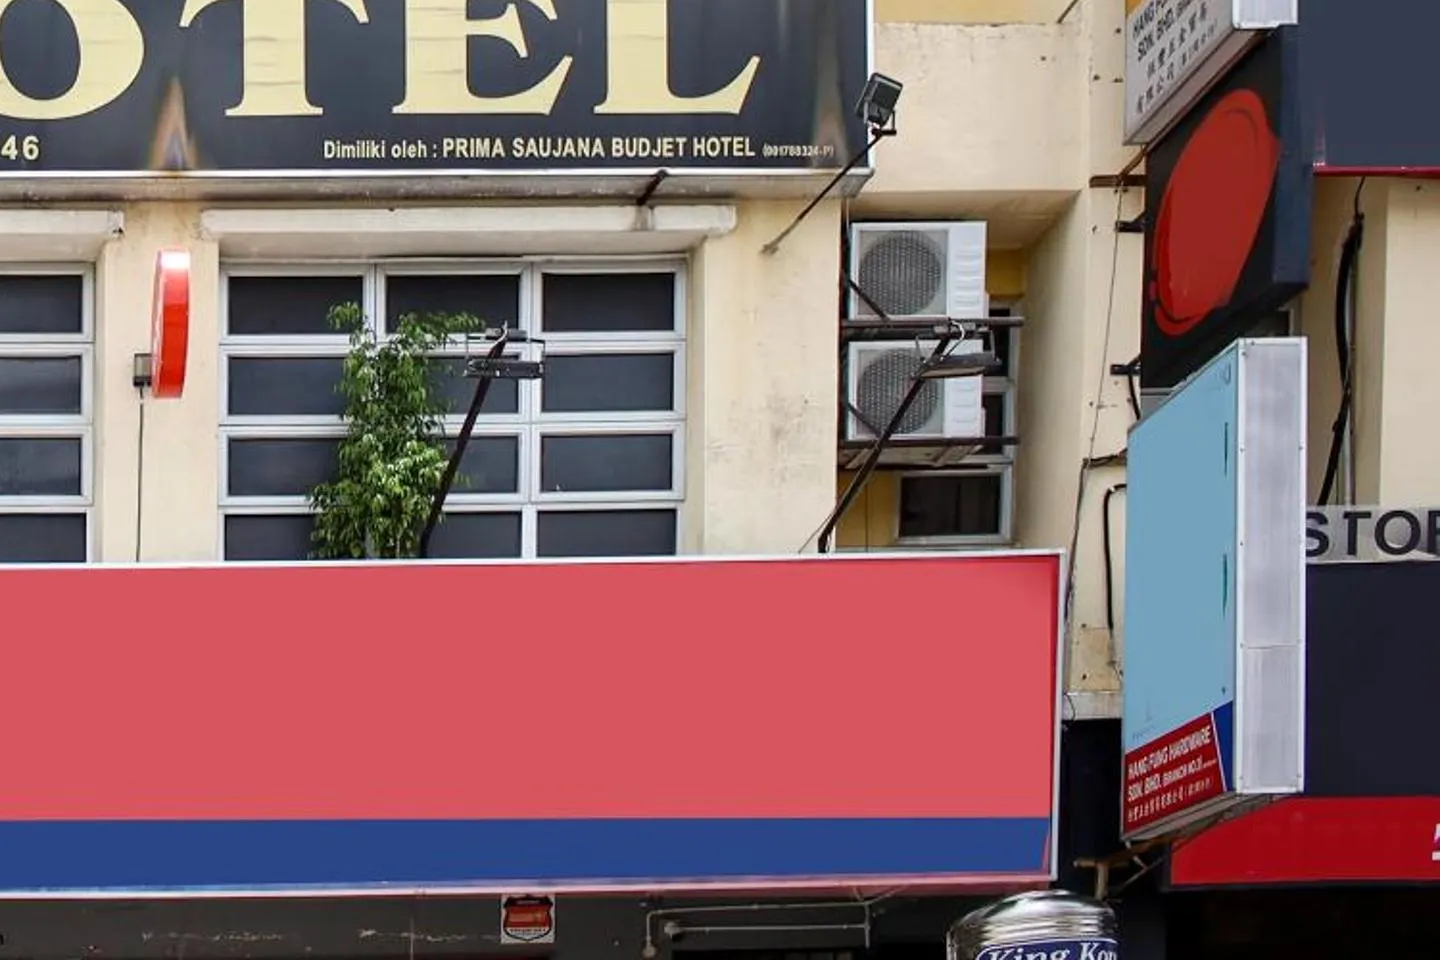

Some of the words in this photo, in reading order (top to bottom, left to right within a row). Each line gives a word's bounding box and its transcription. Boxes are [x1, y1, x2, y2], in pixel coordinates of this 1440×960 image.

[323, 140, 386, 159] Dimiliki
[442, 137, 506, 158] PRIMA
[512, 137, 605, 158] SAUJANA
[611, 137, 687, 158] BUDJET
[693, 136, 756, 157] HOTEL
